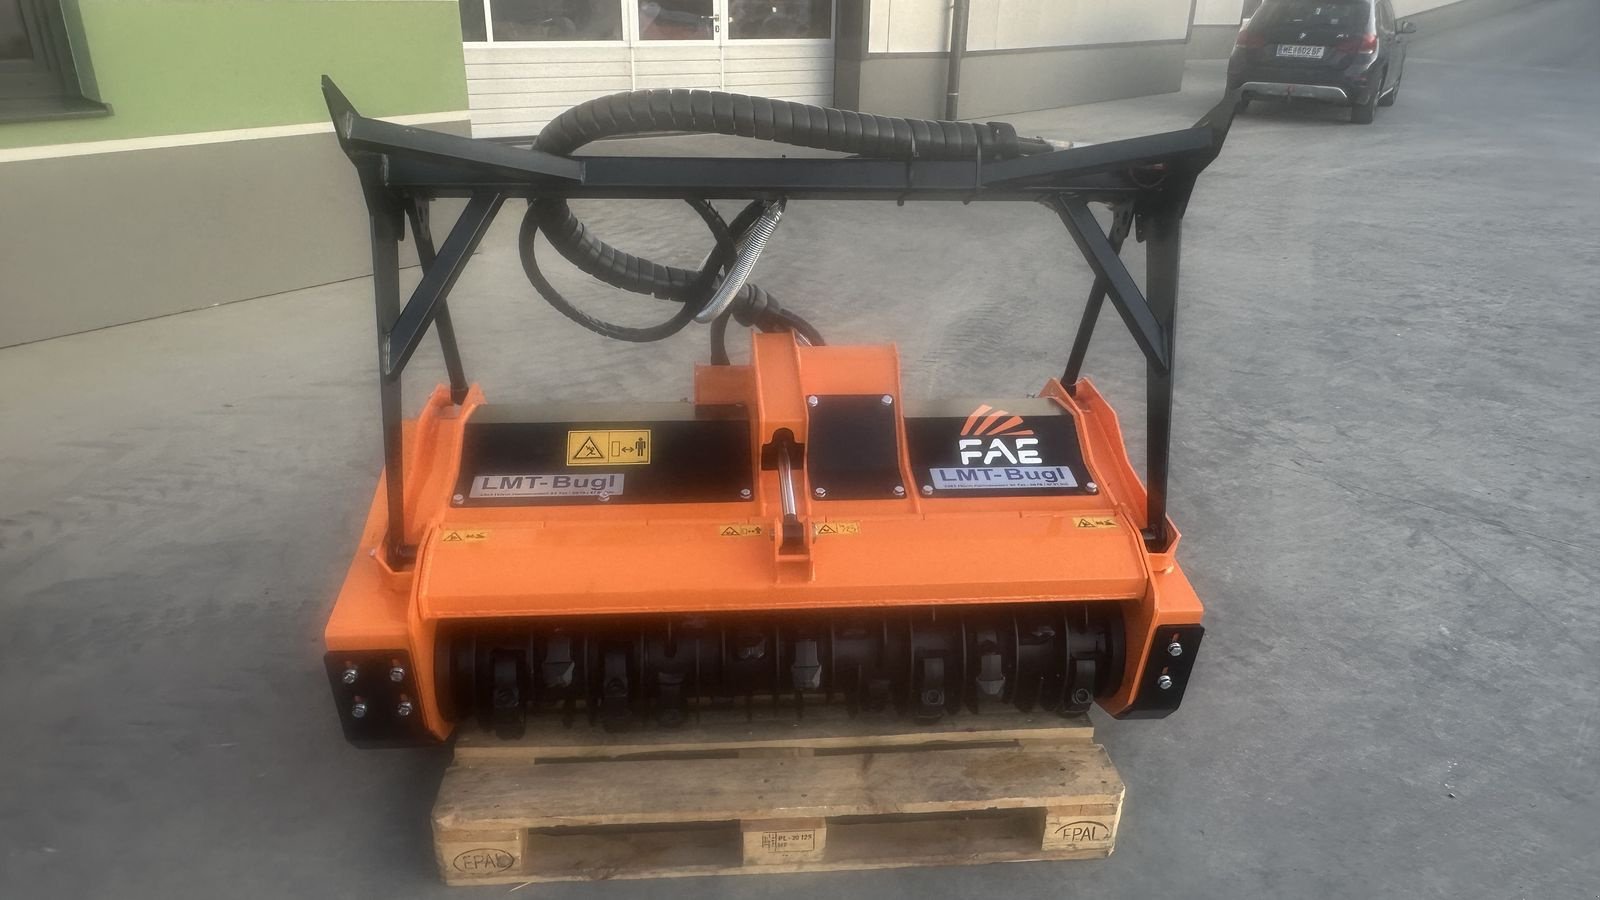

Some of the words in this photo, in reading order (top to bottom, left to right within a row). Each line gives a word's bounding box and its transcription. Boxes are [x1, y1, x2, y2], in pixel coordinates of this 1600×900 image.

[959, 438, 1043, 465] FAE
[939, 467, 1065, 482] LMT-Bugl
[482, 475, 615, 490] LMT-Bugl
